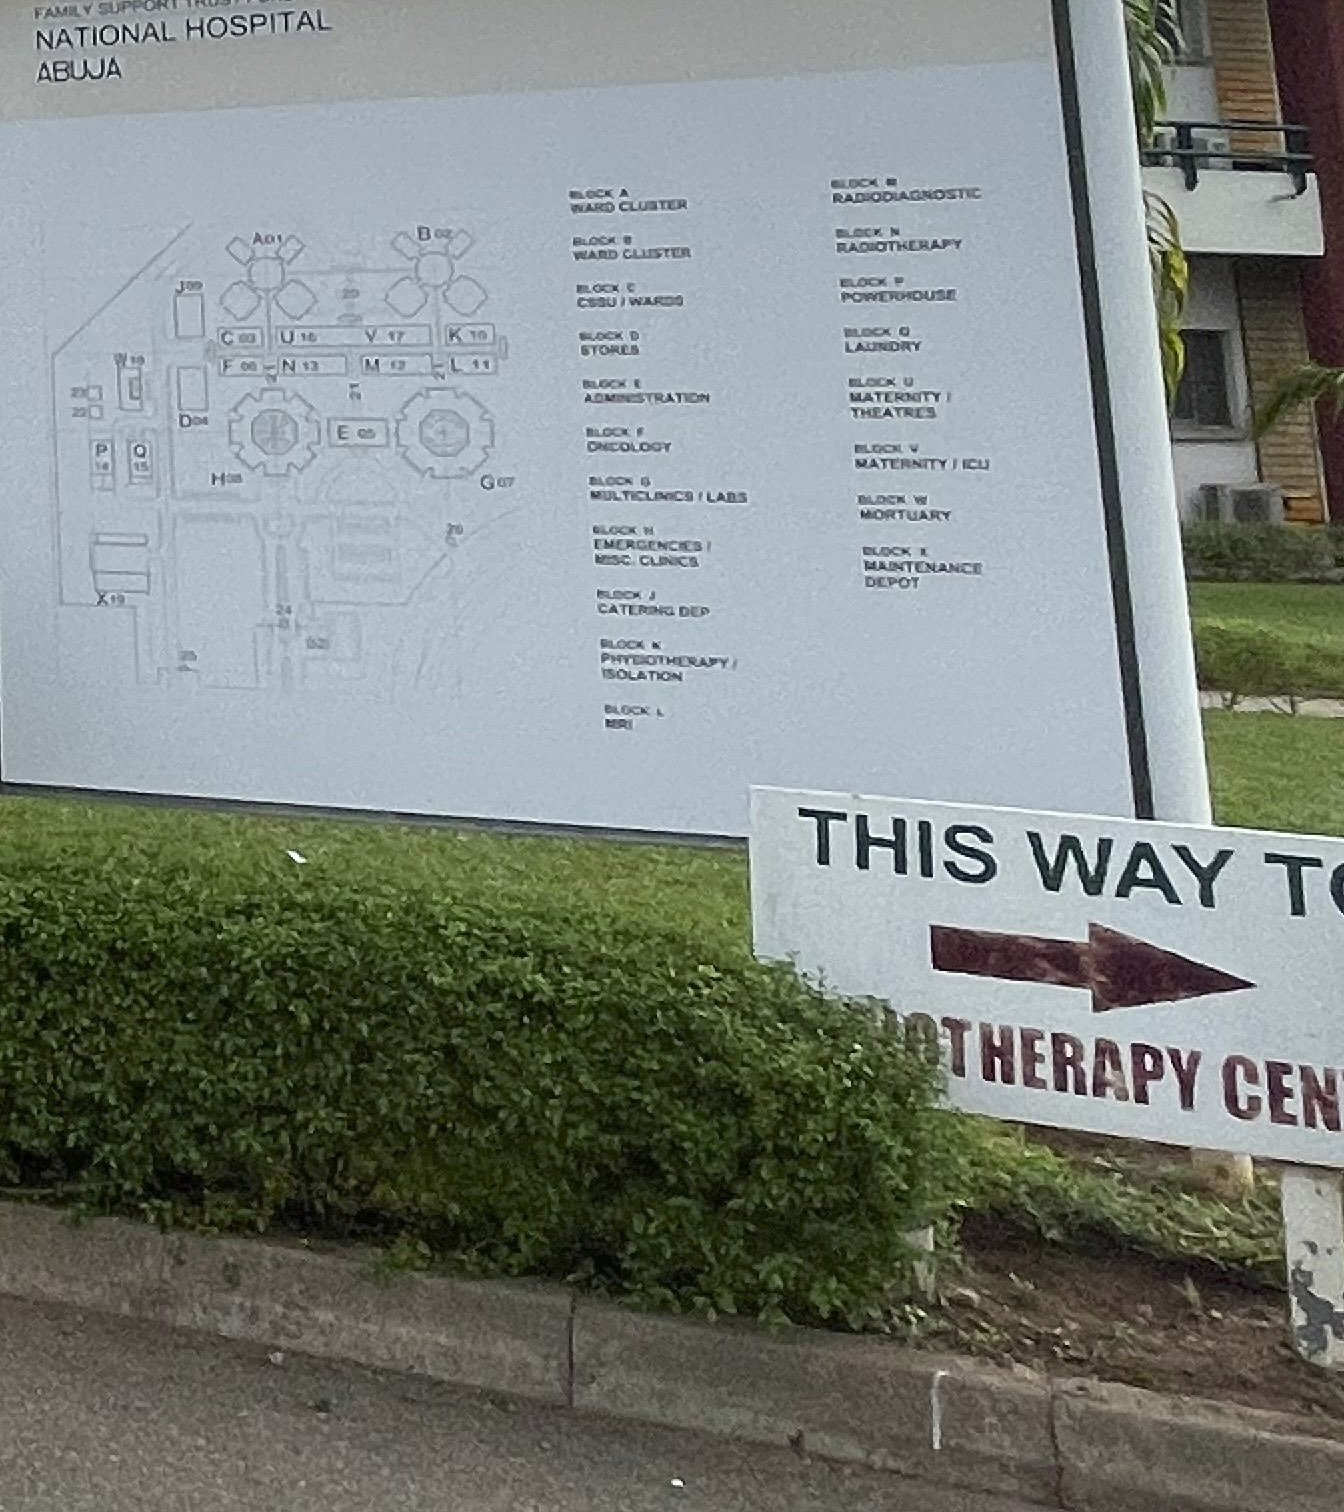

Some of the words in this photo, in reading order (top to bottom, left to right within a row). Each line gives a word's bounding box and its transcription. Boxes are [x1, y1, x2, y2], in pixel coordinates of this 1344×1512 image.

[34, 5, 94, 20] FAMILY
[36, 22, 177, 50] NATIONAL
[186, 9, 333, 39] HOSPITAL
[36, 57, 122, 84] ABUJA
[569, 189, 613, 199] BLOCK
[833, 188, 981, 203] RADIODIAGNOSTIC
[571, 203, 615, 214] WARD
[619, 199, 687, 211] CLUSTER
[573, 237, 615, 246] BLOCK
[836, 240, 962, 253] RADIOTHERAPY
[574, 250, 617, 260] WARD
[623, 248, 691, 259] CLUSTER
[630, 296, 683, 306] WARDS
[841, 290, 956, 302] POWERHOUSE
[843, 327, 891, 337] BLOCK
[845, 341, 921, 353] LAUNDRY
[583, 379, 625, 388] BLOCK
[849, 378, 895, 387] BLOCK
[584, 393, 710, 403] ADMINISTRATION
[849, 392, 941, 402] MATERNITY
[851, 407, 936, 418] THEATRES
[587, 428, 630, 436] BLOCK
[587, 441, 671, 452] ONCOLOGY
[855, 459, 947, 469] MATERNITY
[963, 459, 989, 470] ICU
[590, 491, 692, 501] MULTICLINICS
[707, 492, 747, 503] LABS
[861, 509, 950, 521] MORTUARY
[639, 555, 699, 567] CLINICS
[864, 561, 981, 574] MAINTENANCE
[865, 577, 919, 588] DEPOT
[598, 604, 675, 615] CATERING
[602, 670, 683, 681] ISOLATION
[798, 807, 997, 884] THIS
[1027, 830, 1234, 909] WAY
[1221, 1053, 1344, 1133] CEN
